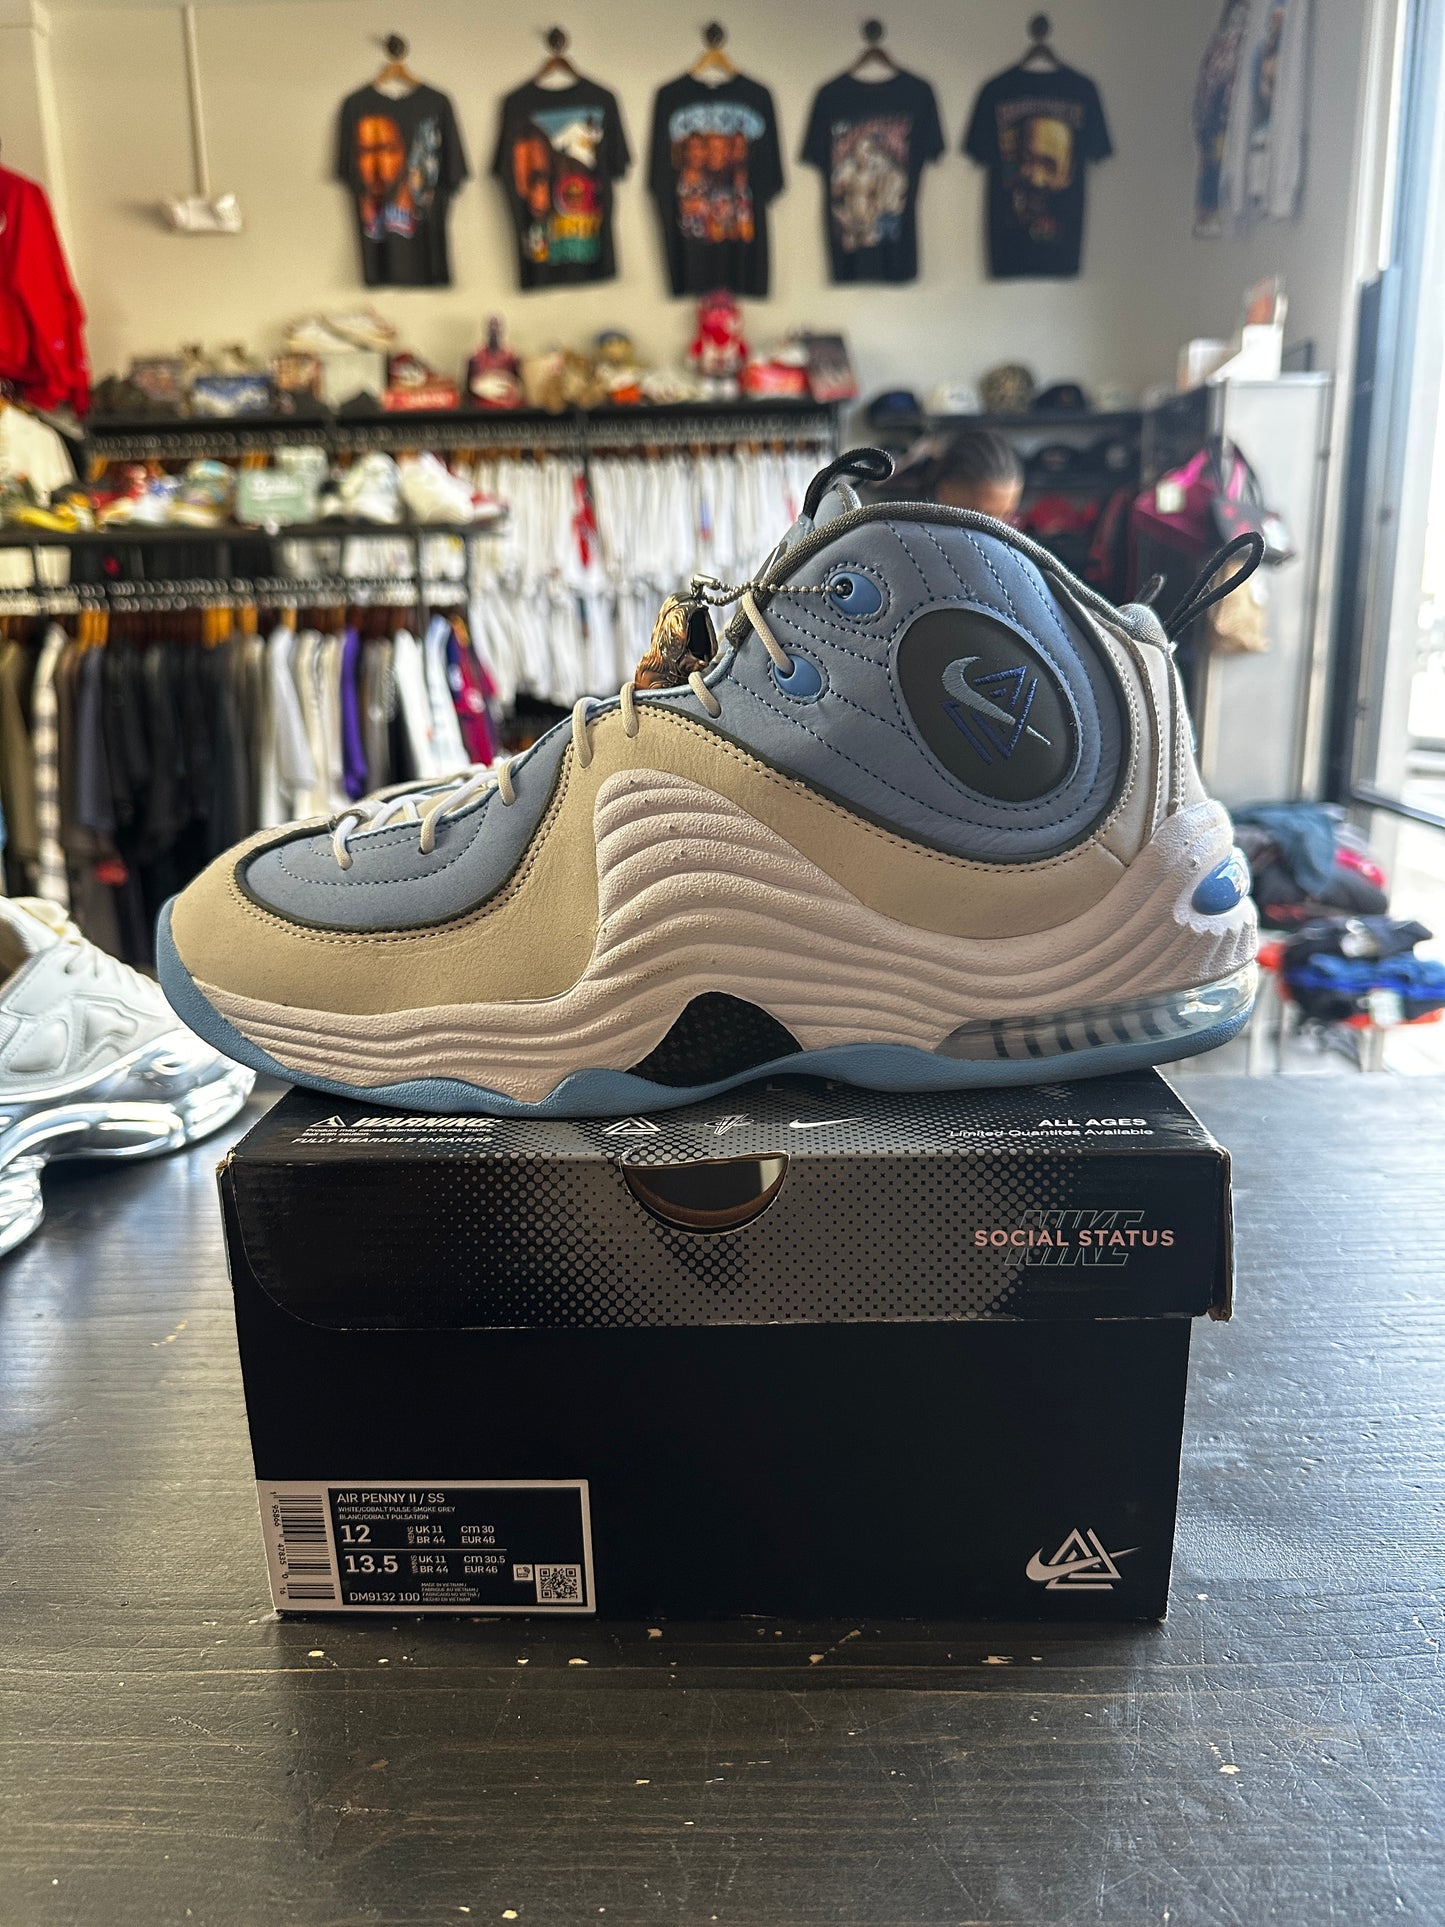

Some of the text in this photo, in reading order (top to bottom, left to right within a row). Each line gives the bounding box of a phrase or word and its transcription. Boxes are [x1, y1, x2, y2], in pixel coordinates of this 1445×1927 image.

[1038, 1118, 1147, 1127] ALL AGES
[974, 1229, 1175, 1247] SOCIAL STATUS
[337, 1493, 358, 1503] AIR
[361, 1493, 406, 1503] PENNY
[409, 1493, 416, 1503] II
[428, 1493, 445, 1503] SS
[340, 1524, 372, 1543] 12
[415, 1525, 443, 1534] UK 11
[482, 1525, 495, 1534] 30
[416, 1535, 446, 1544] BR 44
[461, 1535, 496, 1544] EUR 46
[345, 1554, 399, 1573] 13.5
[419, 1555, 446, 1564] UK 11
[484, 1555, 506, 1564] 30.5
[420, 1565, 449, 1574] BR 44
[464, 1565, 498, 1574] EUR 46
[350, 1591, 420, 1602] DM9132 100
